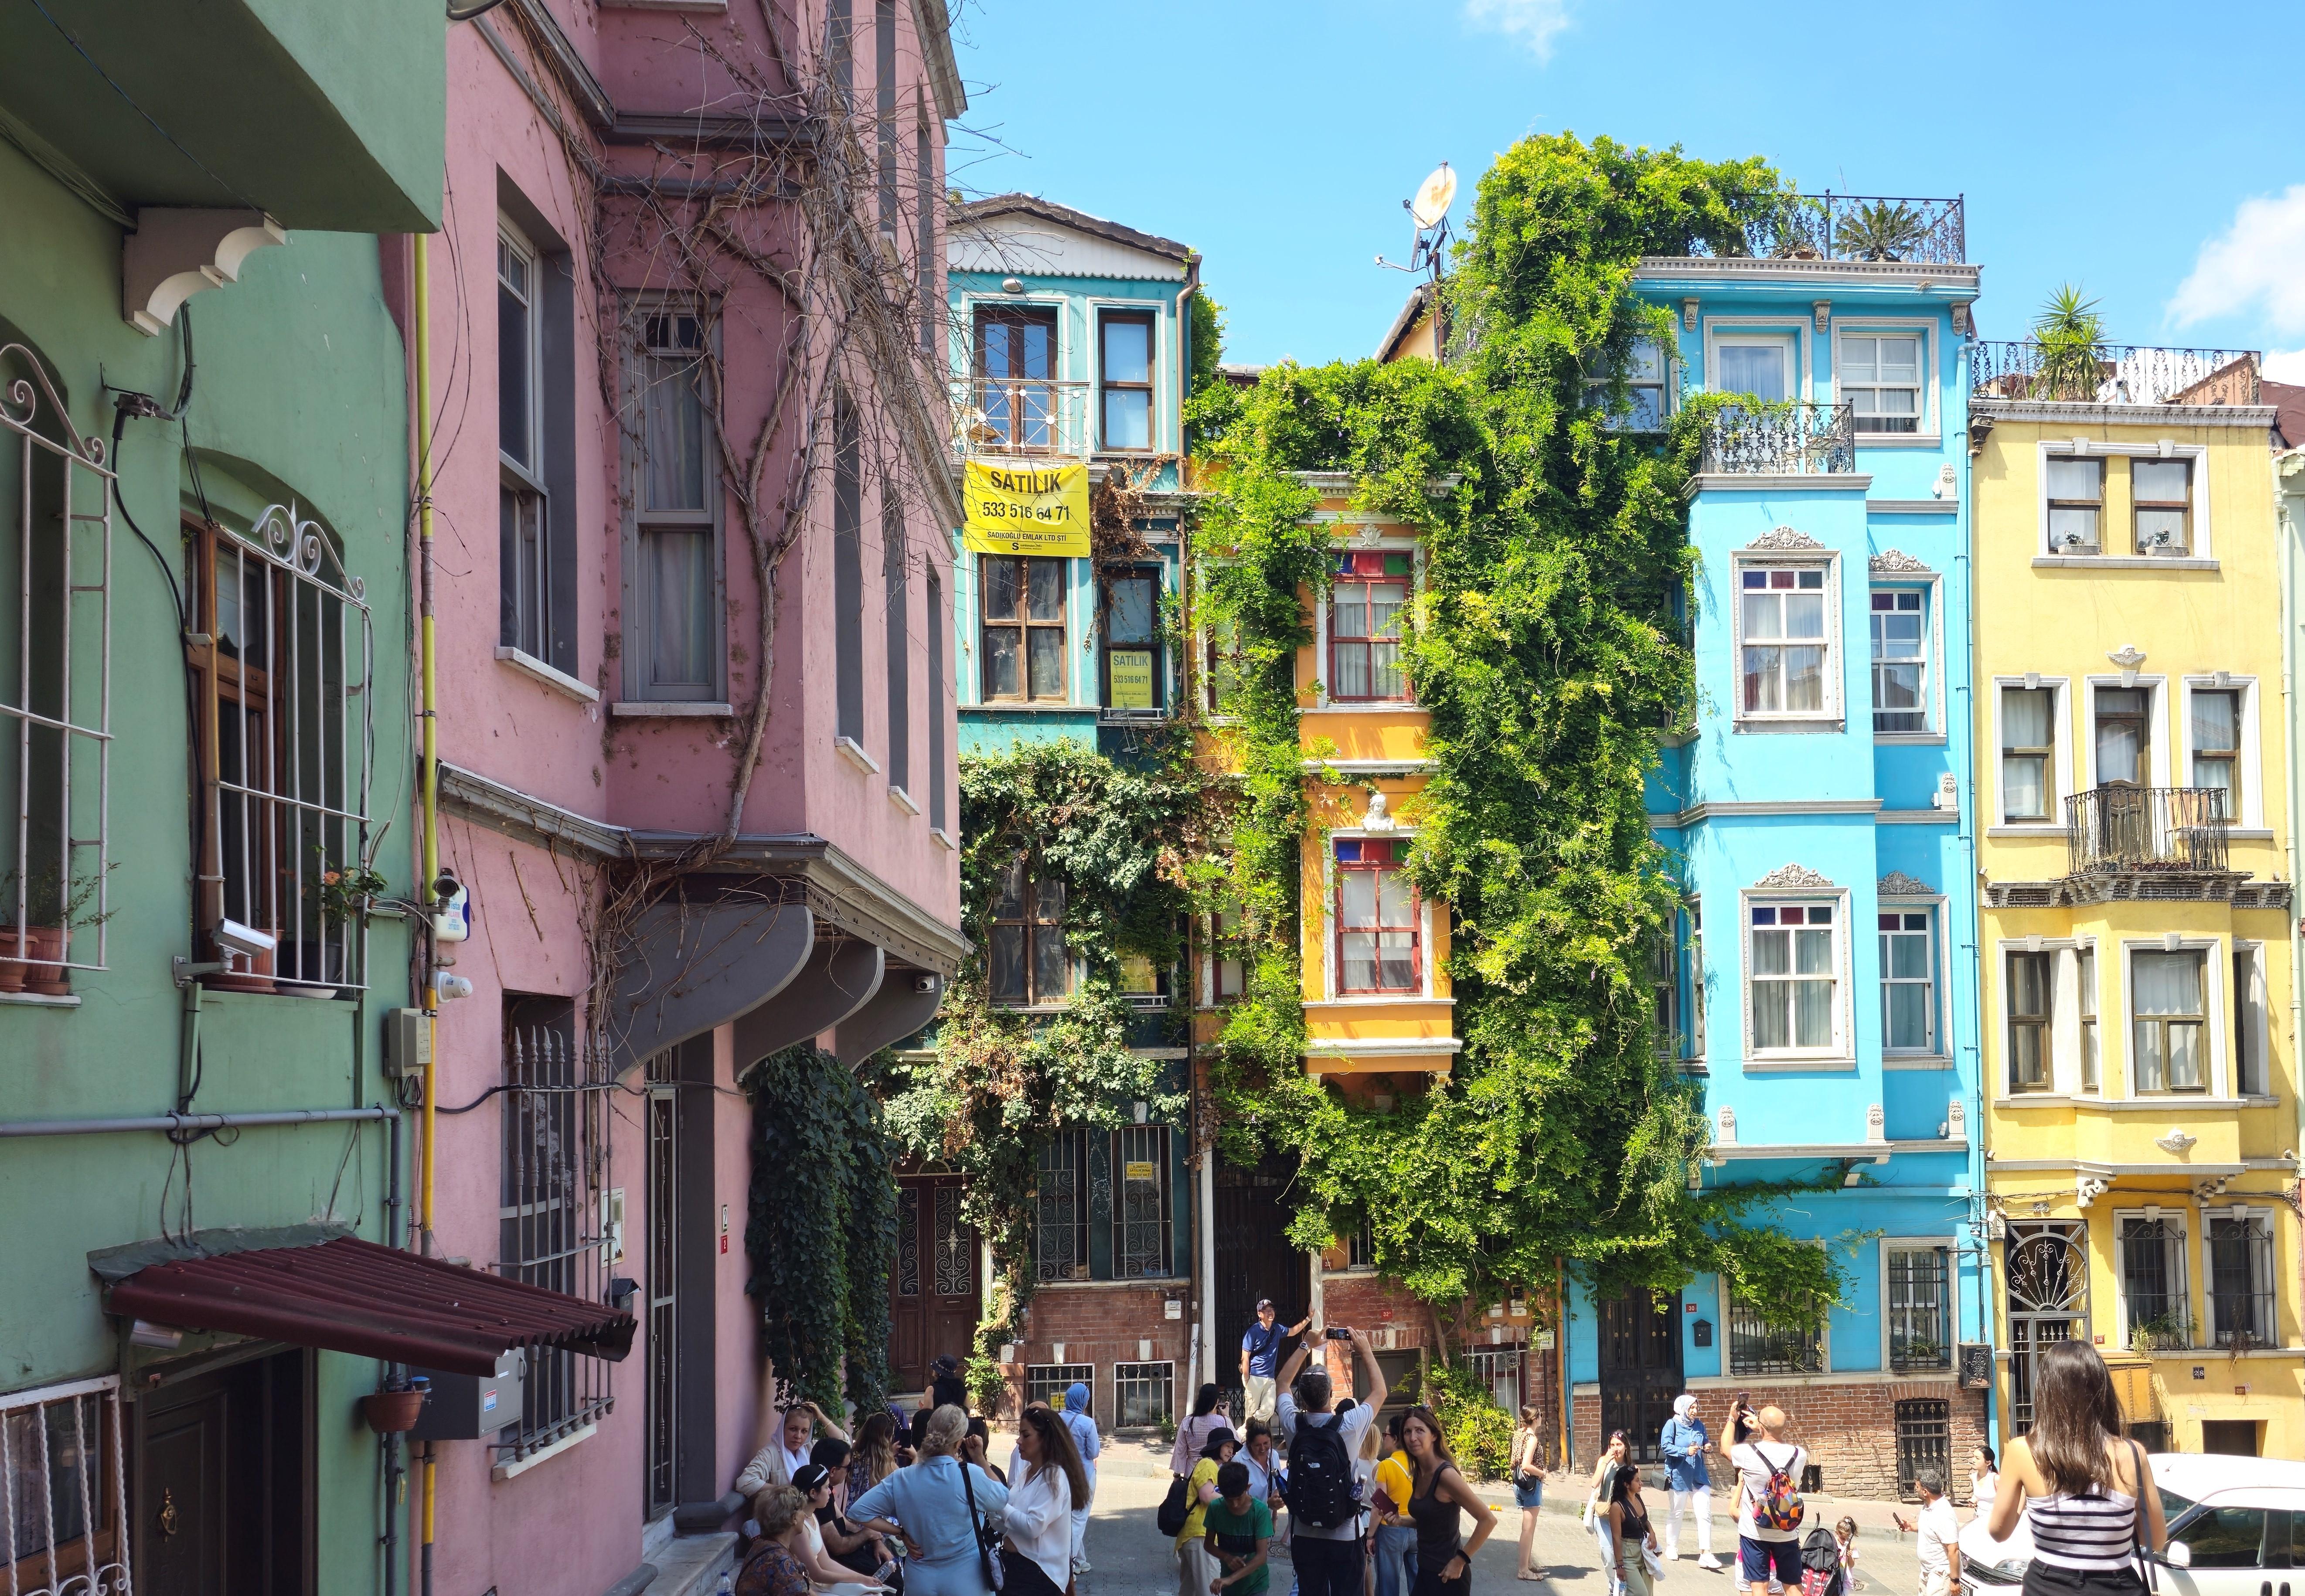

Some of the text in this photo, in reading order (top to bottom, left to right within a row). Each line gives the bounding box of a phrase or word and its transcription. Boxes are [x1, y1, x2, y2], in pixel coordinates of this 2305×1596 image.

[991, 471, 1062, 493] SATILIK
[983, 502, 1069, 520] 533 516 64 71
[1057, 534, 1066, 542] ŞTİ
[1113, 655, 1148, 666] SATILIK
[1114, 675, 1123, 684] 533
[724, 1208, 727, 1227] 2
[724, 1240, 726, 1249] 2
